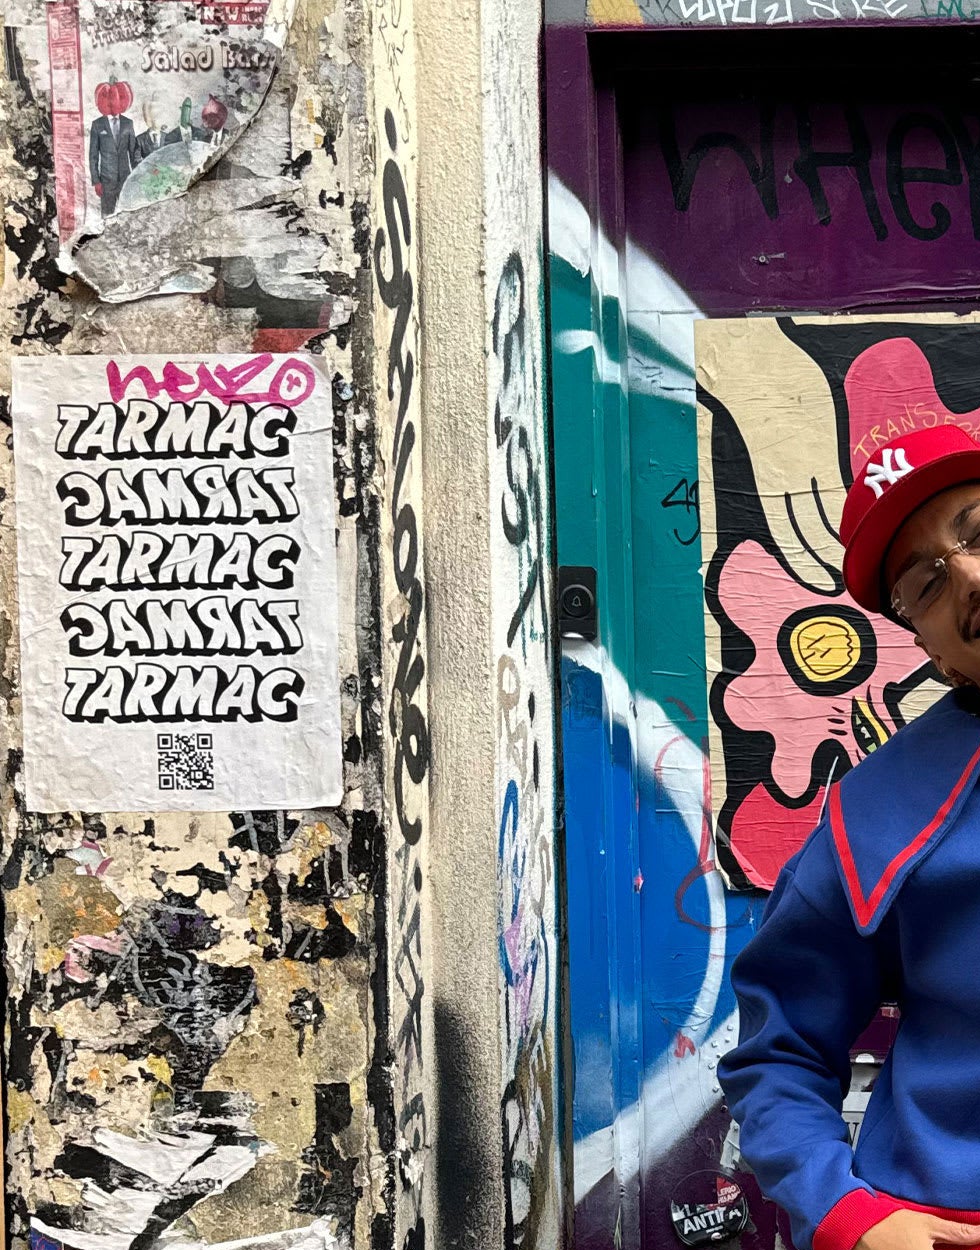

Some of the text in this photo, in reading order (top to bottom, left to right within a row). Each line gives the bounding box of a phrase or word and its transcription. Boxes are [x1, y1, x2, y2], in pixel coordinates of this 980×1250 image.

[141, 45, 214, 72] Salad
[55, 401, 298, 460] TARMAC
[58, 533, 302, 591] TARMAC
[62, 665, 305, 723] TARMAC
